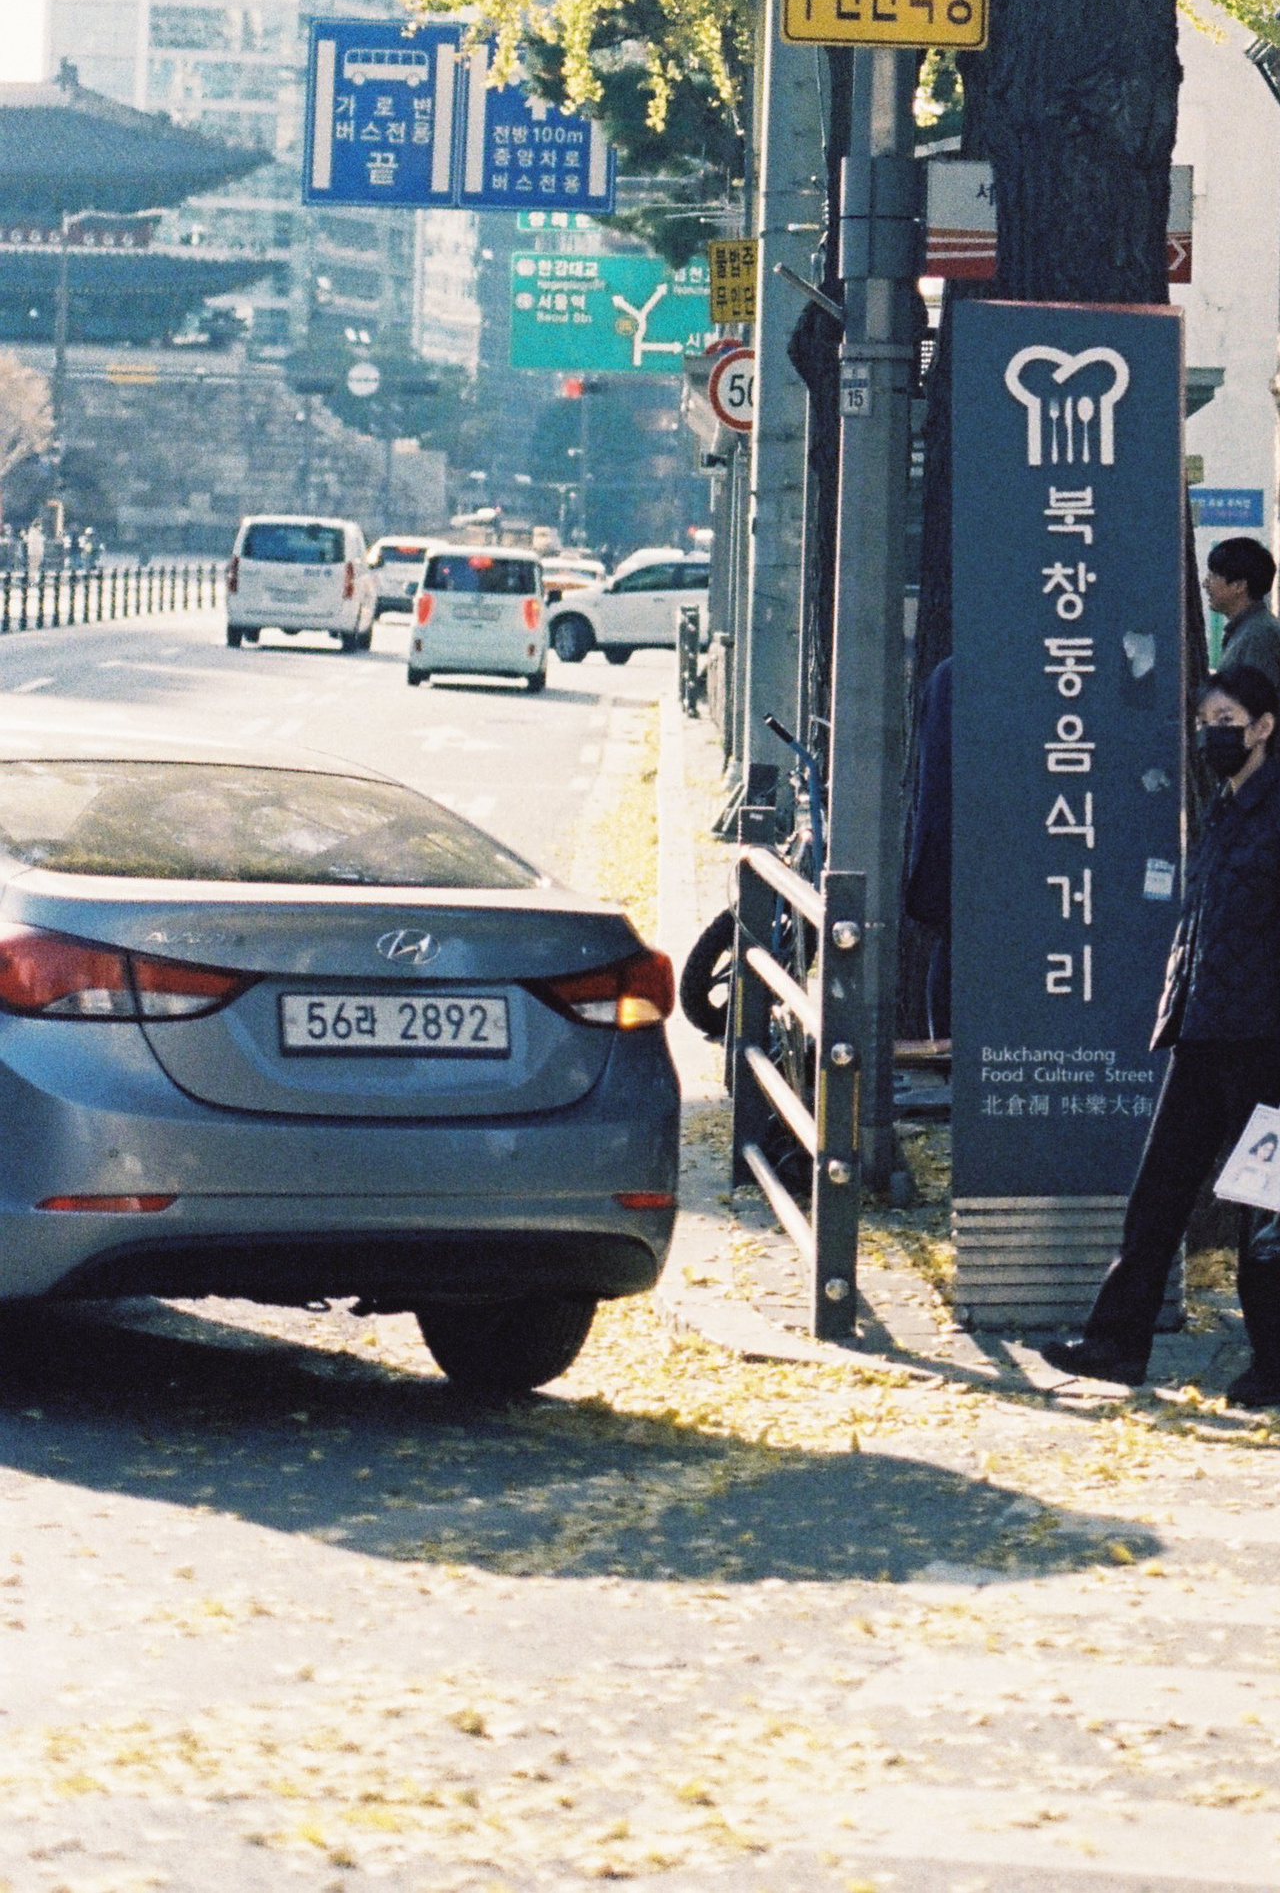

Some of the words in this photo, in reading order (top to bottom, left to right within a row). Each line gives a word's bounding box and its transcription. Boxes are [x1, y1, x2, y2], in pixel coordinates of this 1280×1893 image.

[365, 152, 399, 186] 끝
[728, 374, 755, 408] 5
[848, 389, 864, 408] 15
[399, 1002, 489, 1042] 2892
[981, 1046, 1117, 1065] Bukchang-dong
[981, 1067, 1024, 1083] Food
[1033, 1067, 1096, 1083] Culture
[1105, 1067, 1155, 1083] Street
